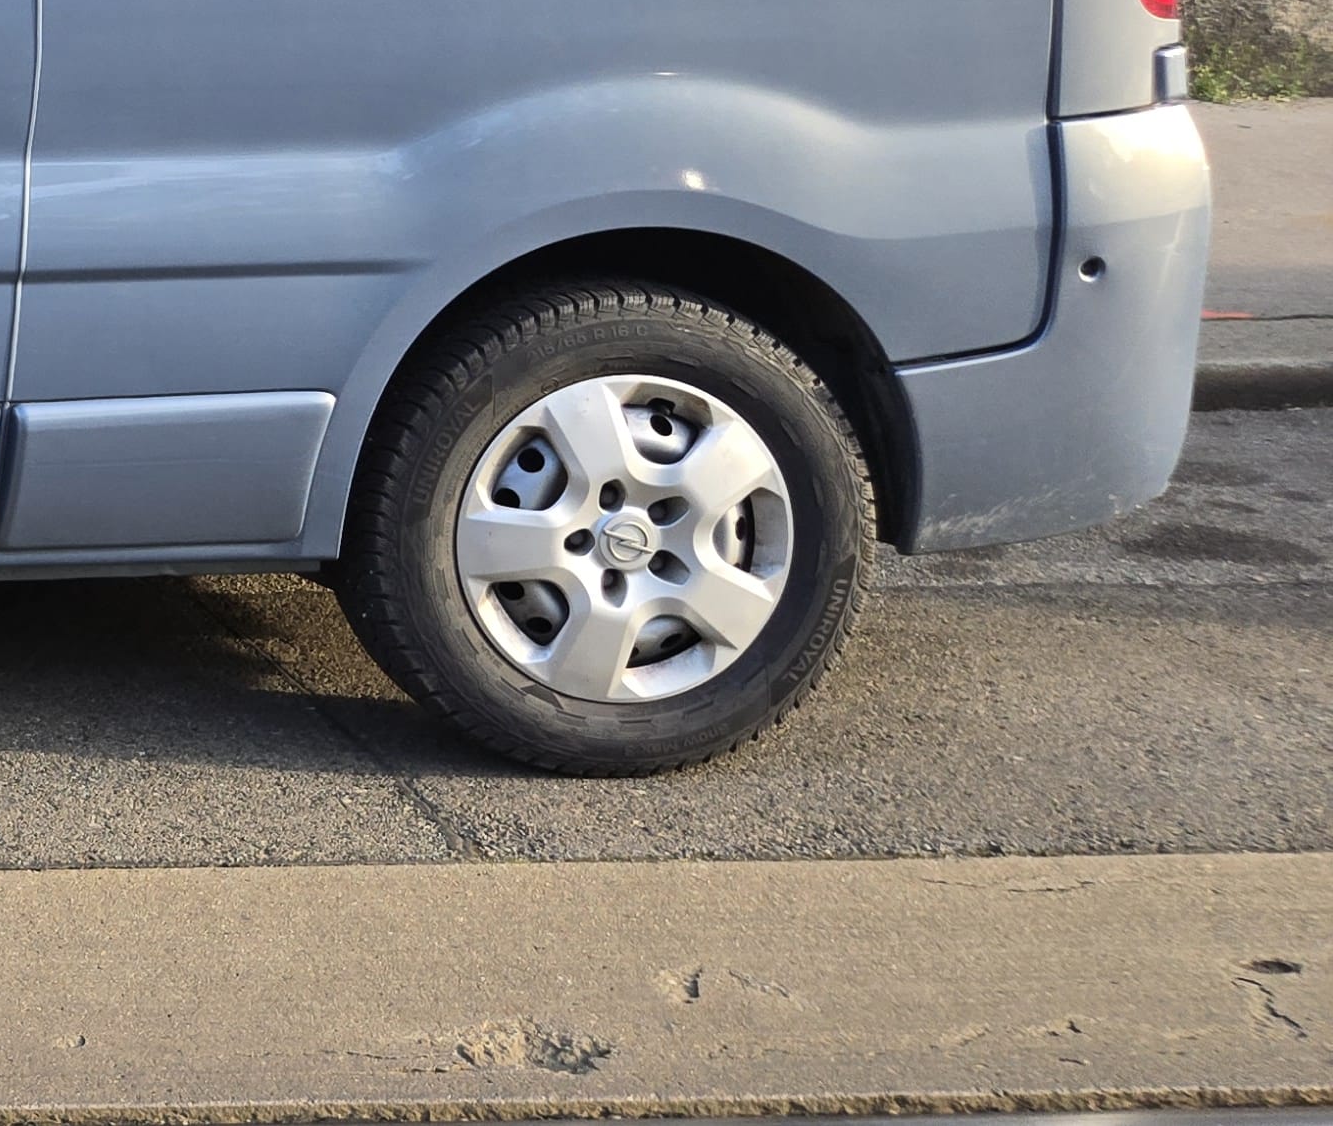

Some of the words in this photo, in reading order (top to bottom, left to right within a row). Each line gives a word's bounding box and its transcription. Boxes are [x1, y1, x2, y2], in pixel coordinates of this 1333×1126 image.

[593, 328, 606, 340] R
[611, 324, 630, 338] 16
[412, 401, 482, 505] UNIROYAL
[788, 578, 849, 681] UNIROYAL
